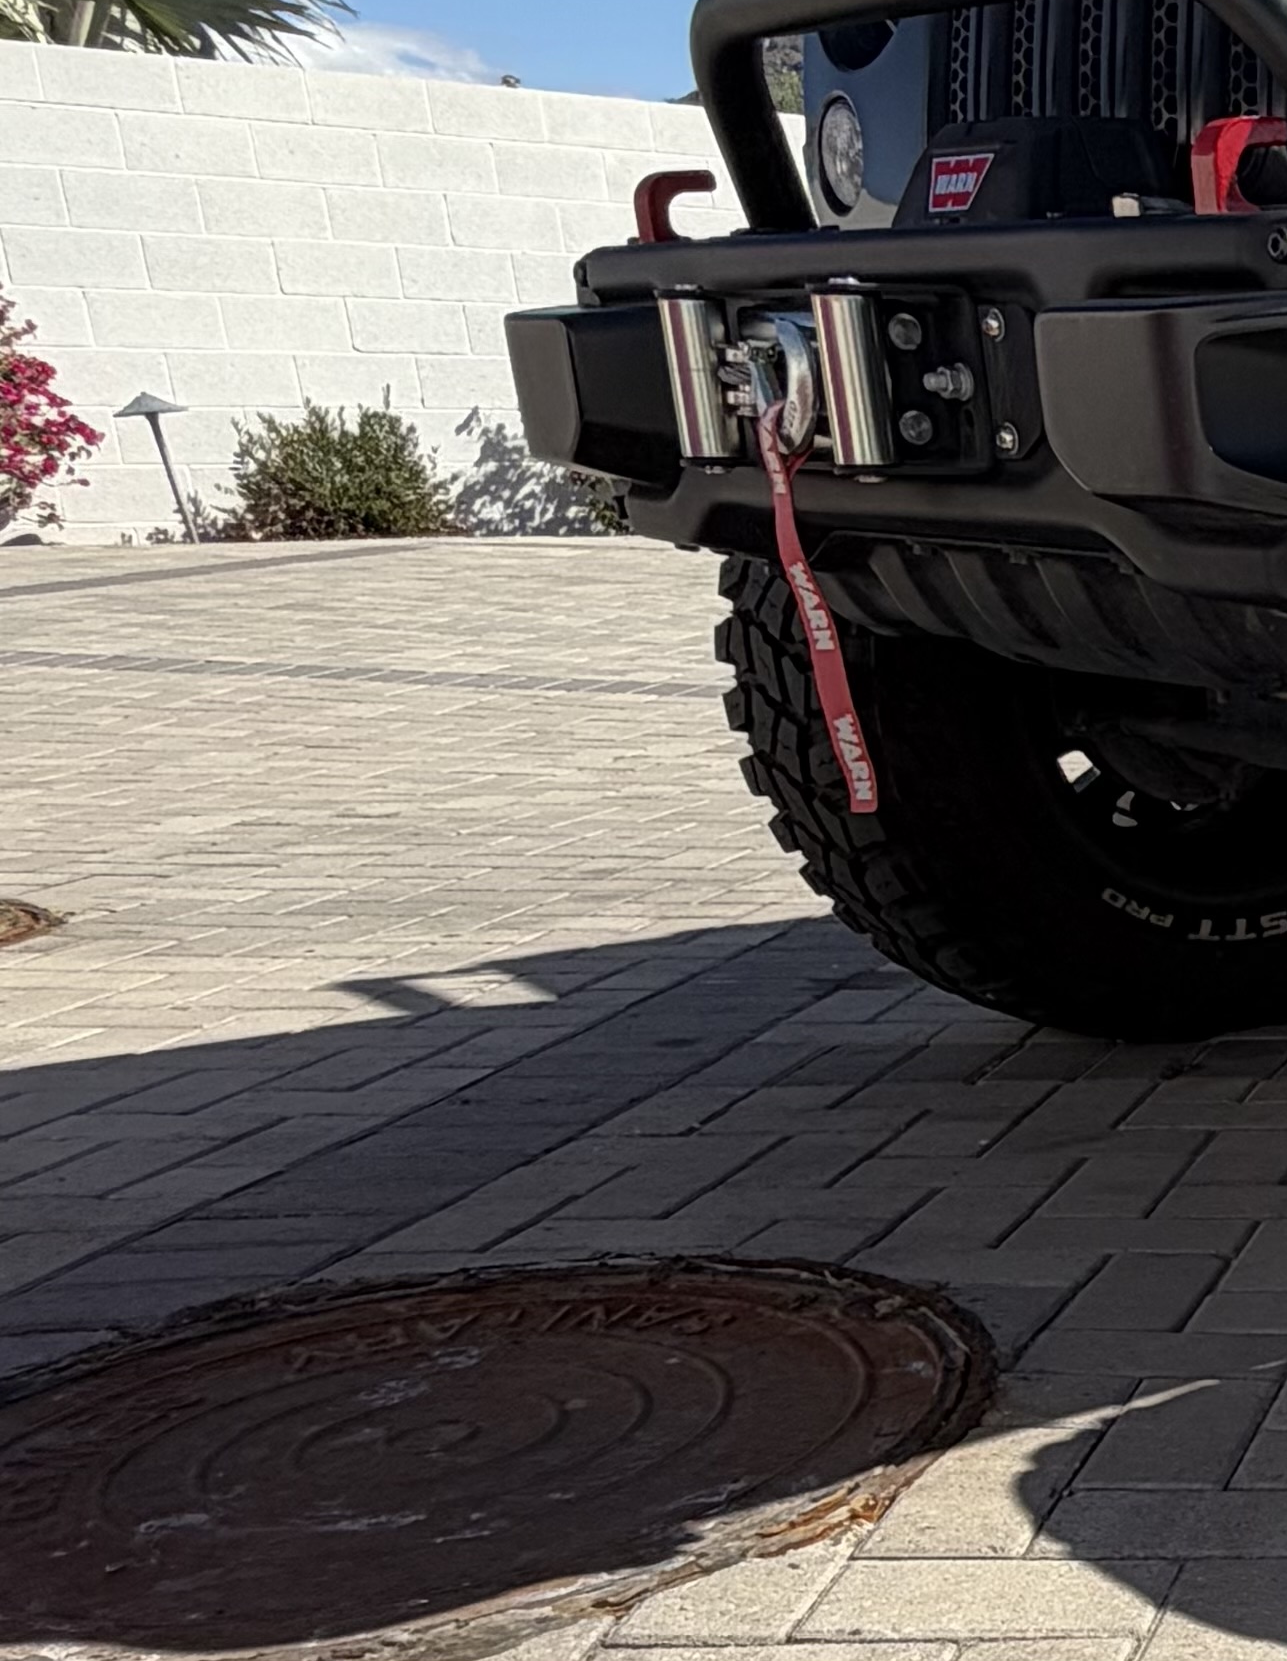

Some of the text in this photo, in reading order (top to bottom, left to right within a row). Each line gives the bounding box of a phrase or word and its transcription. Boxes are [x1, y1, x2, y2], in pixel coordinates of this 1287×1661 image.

[935, 172, 978, 195] WARN
[789, 561, 836, 651] WARN
[833, 713, 873, 800] WARN
[1101, 888, 1174, 928] PRO
